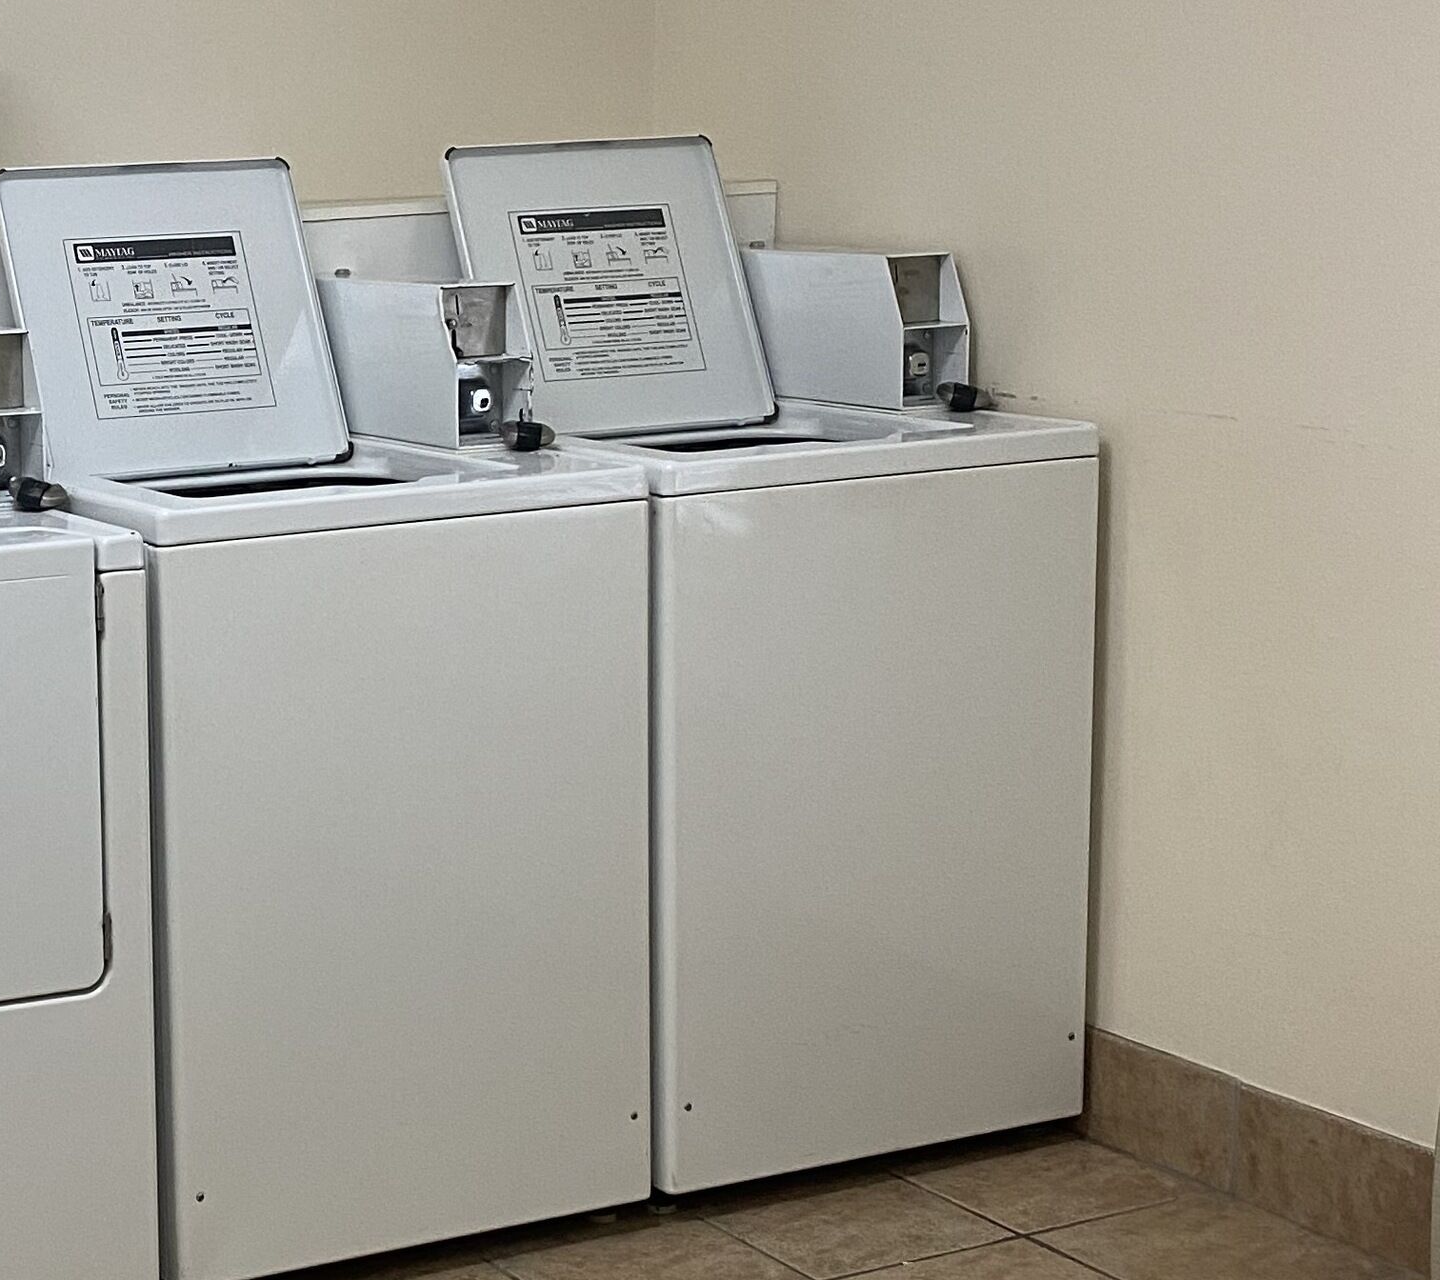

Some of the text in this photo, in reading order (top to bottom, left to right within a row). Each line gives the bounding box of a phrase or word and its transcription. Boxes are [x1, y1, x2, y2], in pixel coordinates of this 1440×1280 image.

[537, 219, 574, 228] MAYTAG
[95, 247, 135, 257] MAYTAG
[90, 318, 134, 326] TEMPERATURE
